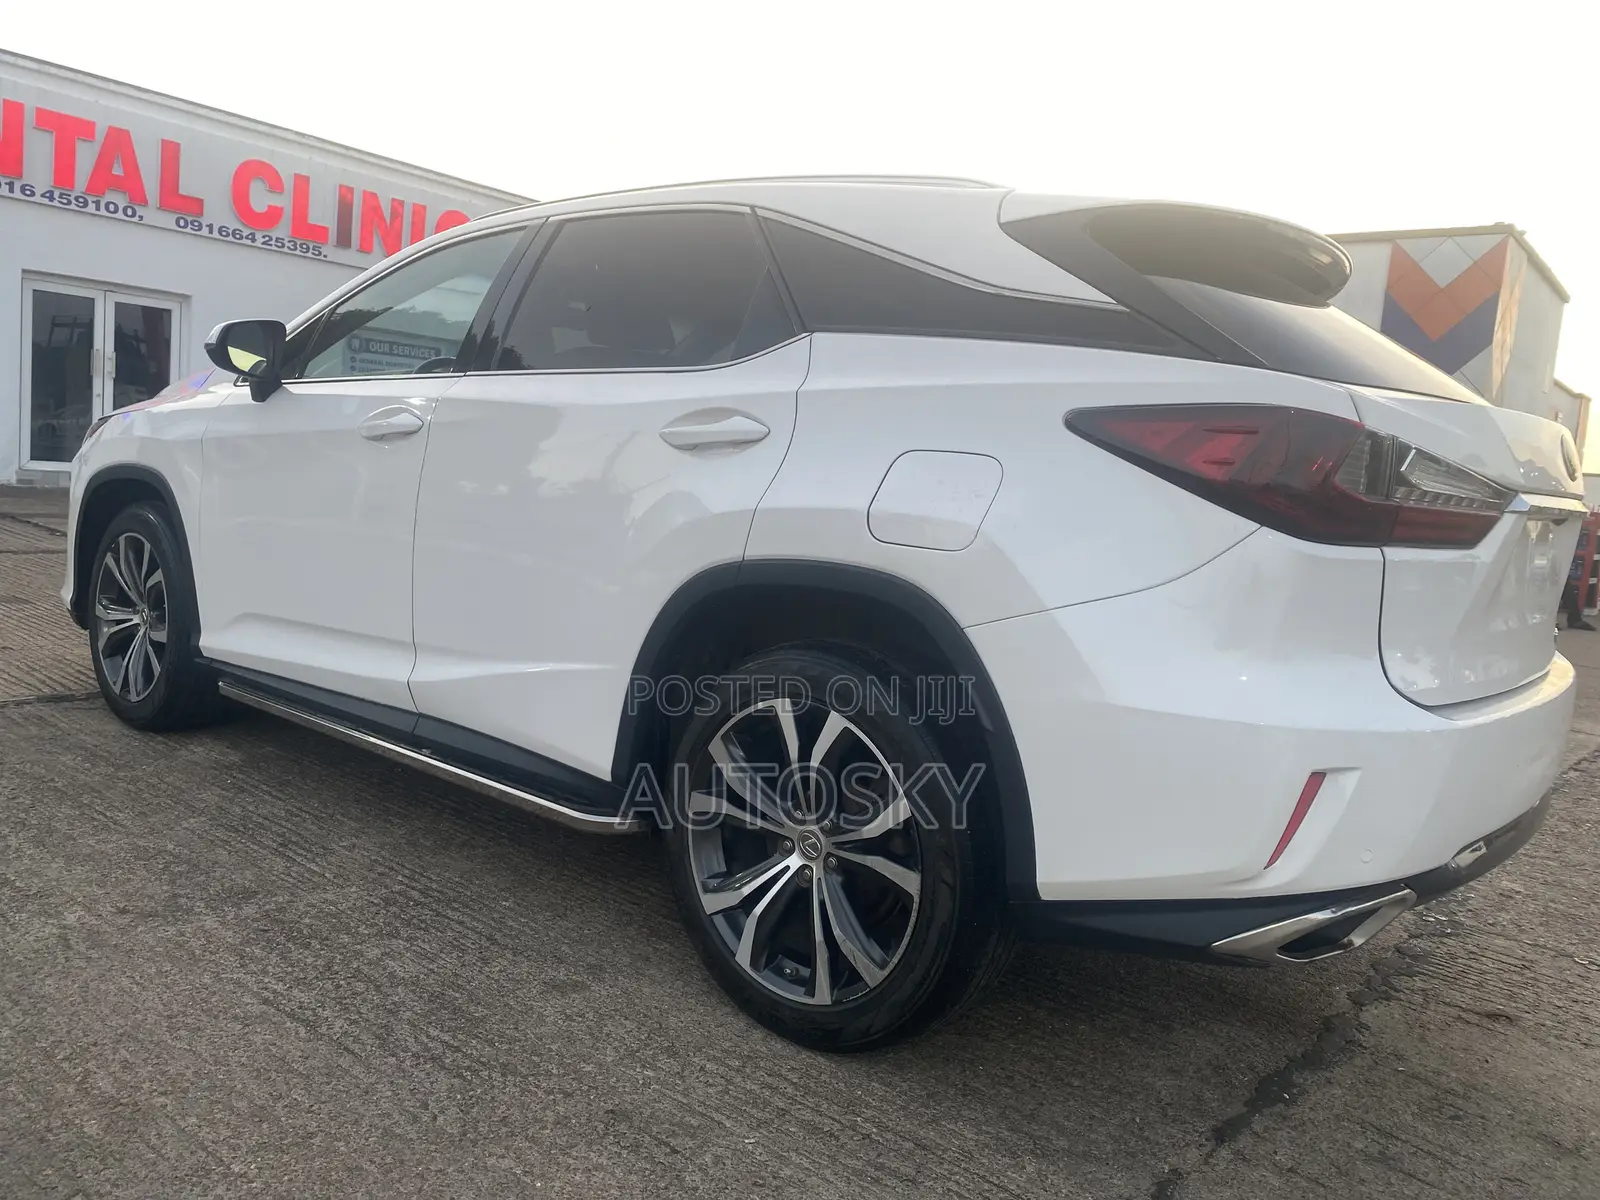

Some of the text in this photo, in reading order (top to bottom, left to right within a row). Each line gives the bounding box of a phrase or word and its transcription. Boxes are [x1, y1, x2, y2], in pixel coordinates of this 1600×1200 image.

[0, 180, 144, 222] 16459100,
[369, 341, 436, 359] OUR SERVICES
